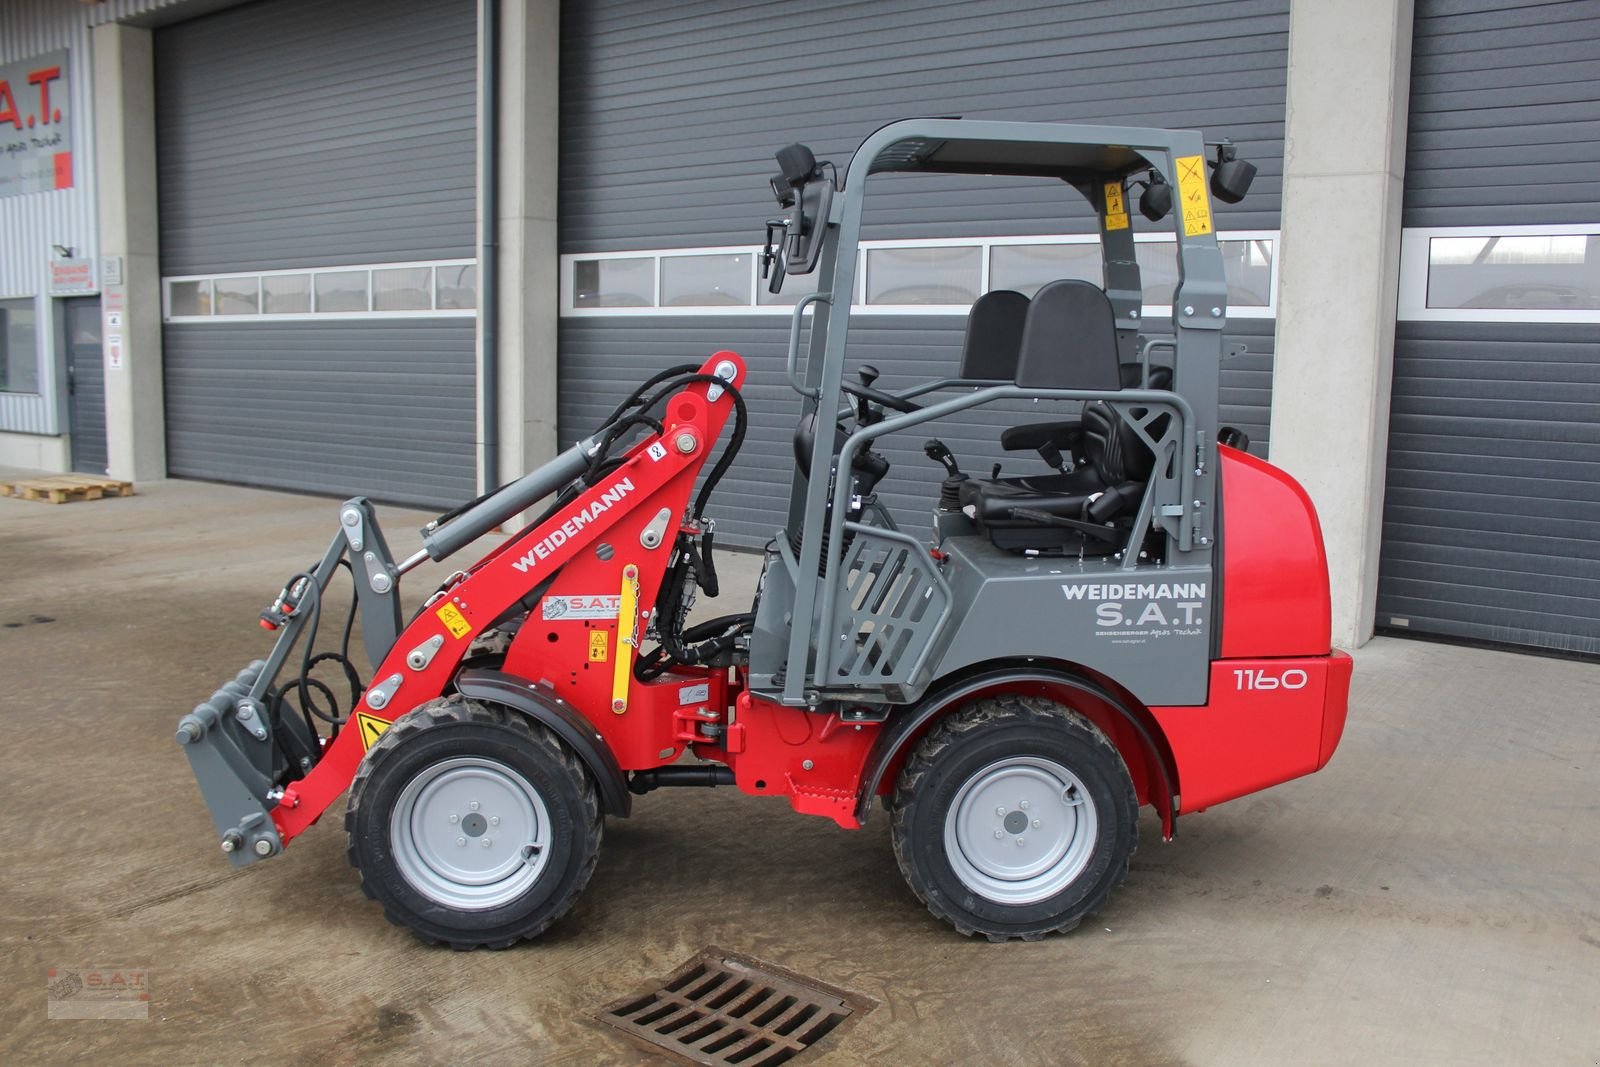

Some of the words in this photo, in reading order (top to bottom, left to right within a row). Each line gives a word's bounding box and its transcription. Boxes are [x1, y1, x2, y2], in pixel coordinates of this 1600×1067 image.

[511, 476, 636, 573] WEIDEMANN
[1061, 583, 1206, 600] WEIDEMANN
[1095, 602, 1203, 627] S.A.T.
[1233, 669, 1308, 690] 1160
